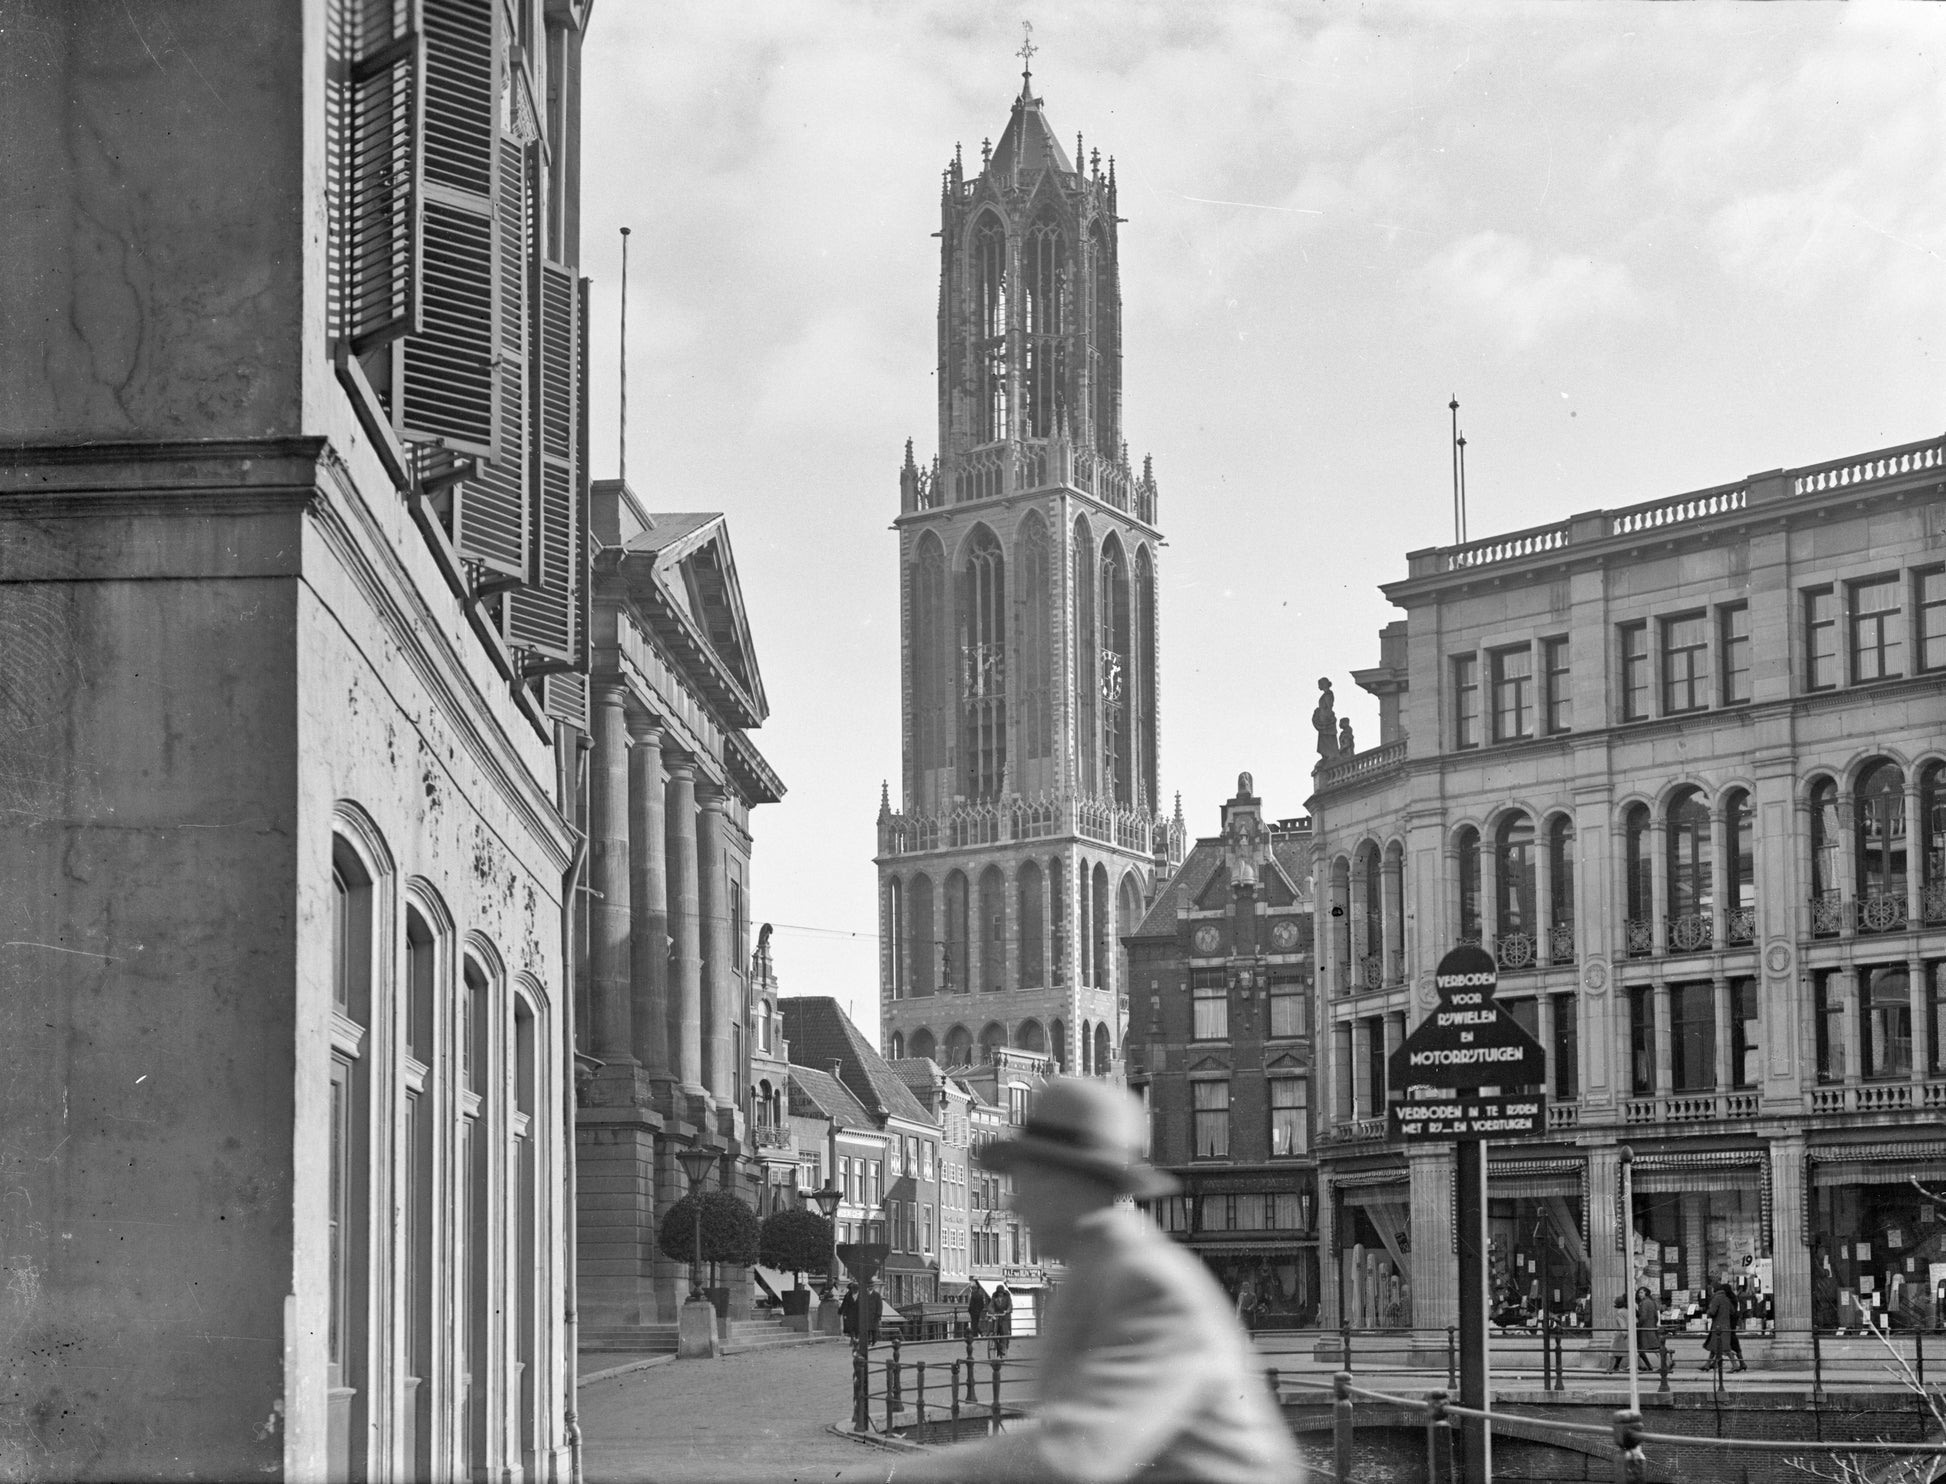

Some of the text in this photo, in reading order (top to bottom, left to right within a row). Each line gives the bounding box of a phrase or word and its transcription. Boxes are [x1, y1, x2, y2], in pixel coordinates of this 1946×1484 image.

[1436, 971, 1497, 988] VERBODEN
[1451, 993, 1482, 1005] VOOR
[1437, 1010, 1497, 1026] RIJWIELEN
[1460, 1031, 1474, 1043] EN
[1410, 1046, 1523, 1065] MOTORRIJTUIGEN
[1395, 1103, 1538, 1120] VERBODEN IN TE RIJDEN
[1402, 1122, 1423, 1134] MET
[1471, 1118, 1532, 1132] VOERTUIGEN
[1742, 1254, 1753, 1267] 19
